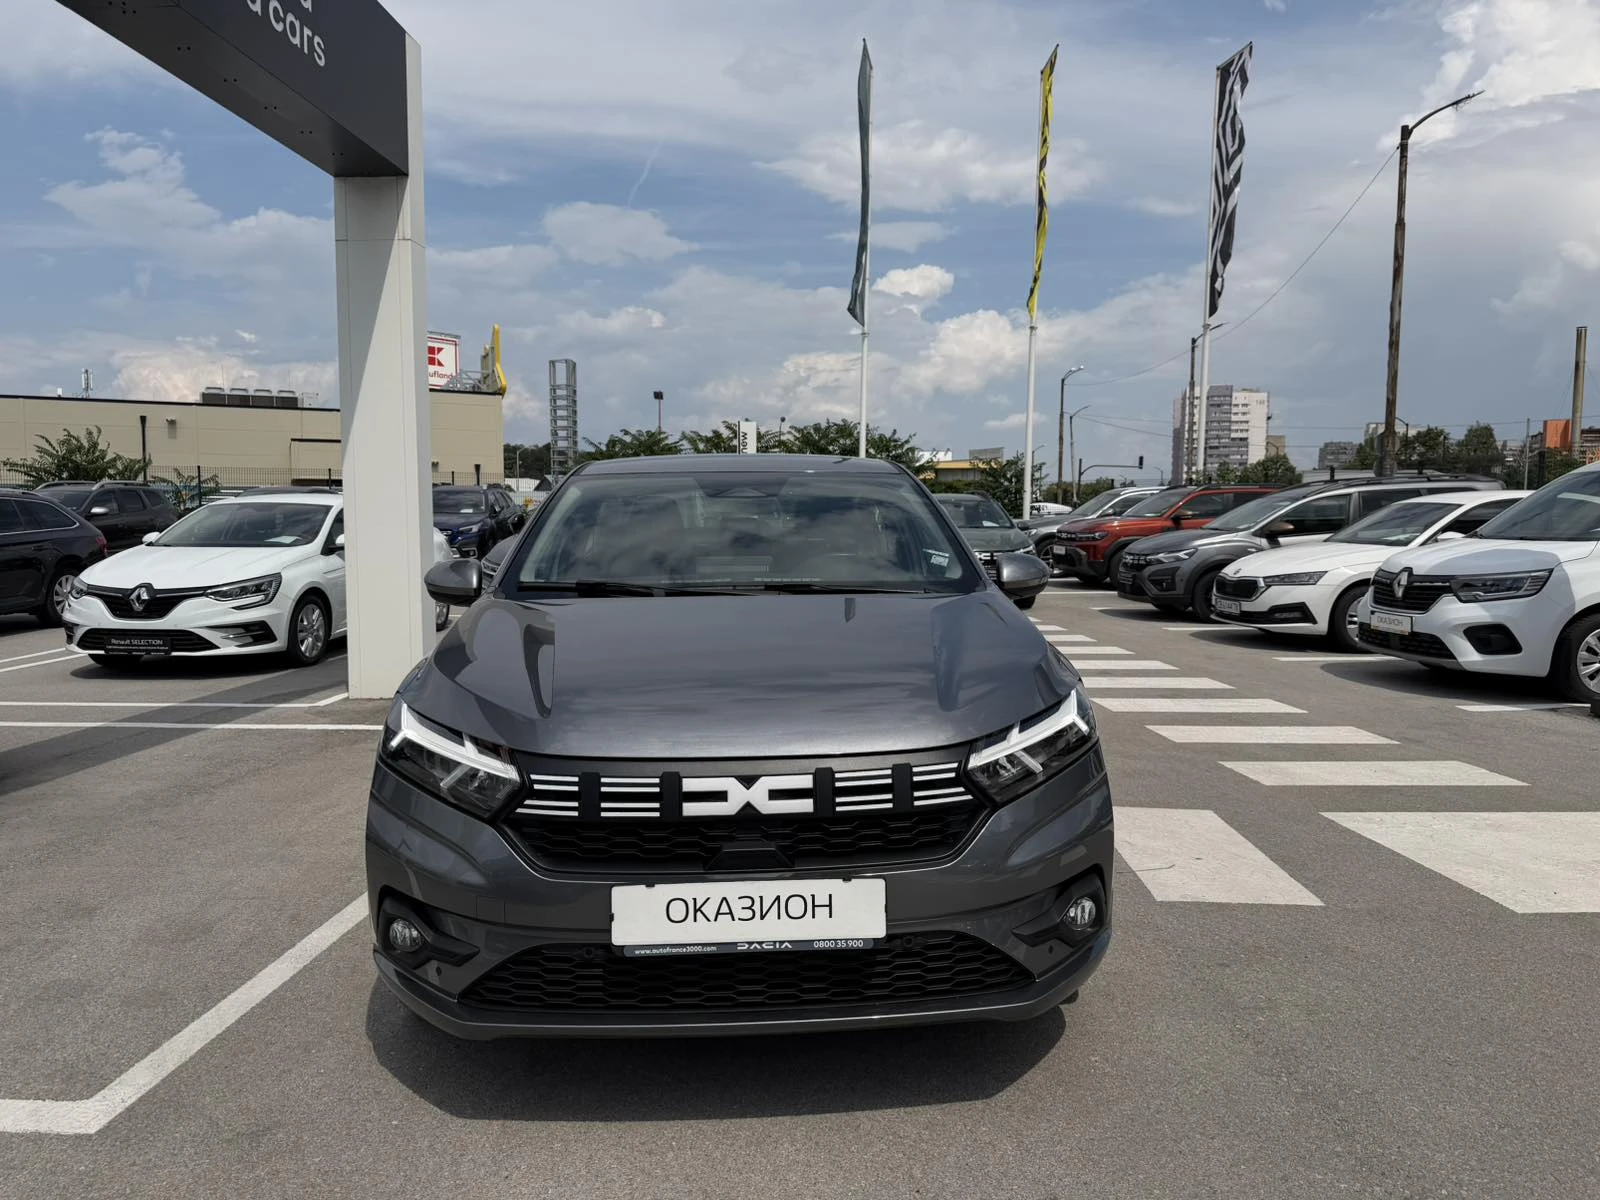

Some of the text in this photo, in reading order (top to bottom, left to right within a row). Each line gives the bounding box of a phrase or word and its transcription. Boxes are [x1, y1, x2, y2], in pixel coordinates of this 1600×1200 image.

[269, 0, 325, 66] cars
[665, 893, 833, 923] ОКАЗИОН
[737, 941, 793, 950] DACIA
[813, 939, 864, 948] 0800 35 900
[634, 945, 717, 955] www.autofrance3000.com
